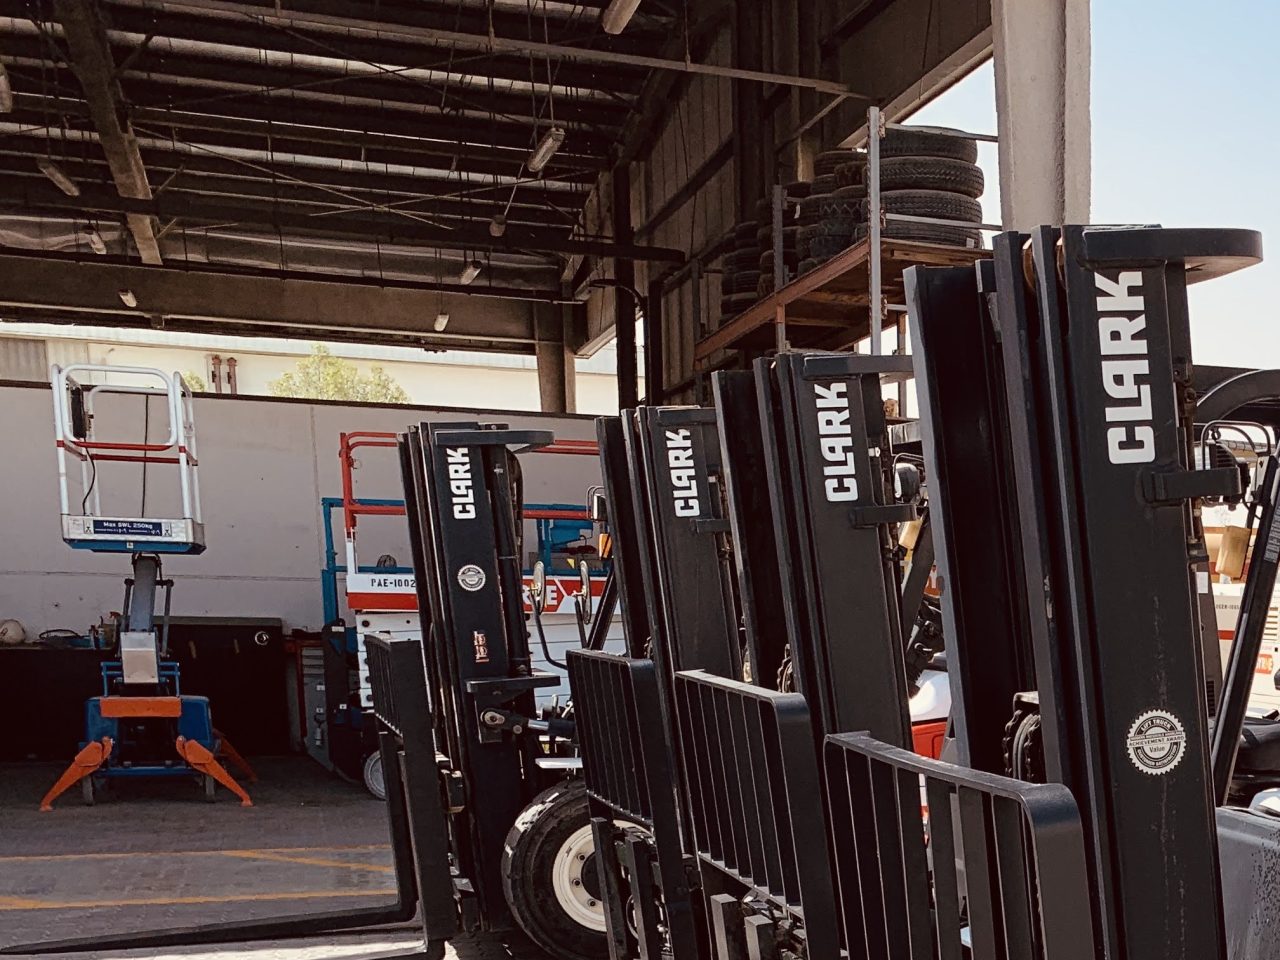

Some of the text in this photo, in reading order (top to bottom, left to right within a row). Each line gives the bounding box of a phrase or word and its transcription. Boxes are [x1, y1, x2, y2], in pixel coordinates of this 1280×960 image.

[1094, 271, 1156, 465] CLARK
[446, 447, 476, 520] CLARK
[665, 428, 700, 518] CLARK
[813, 382, 859, 502] CLARK
